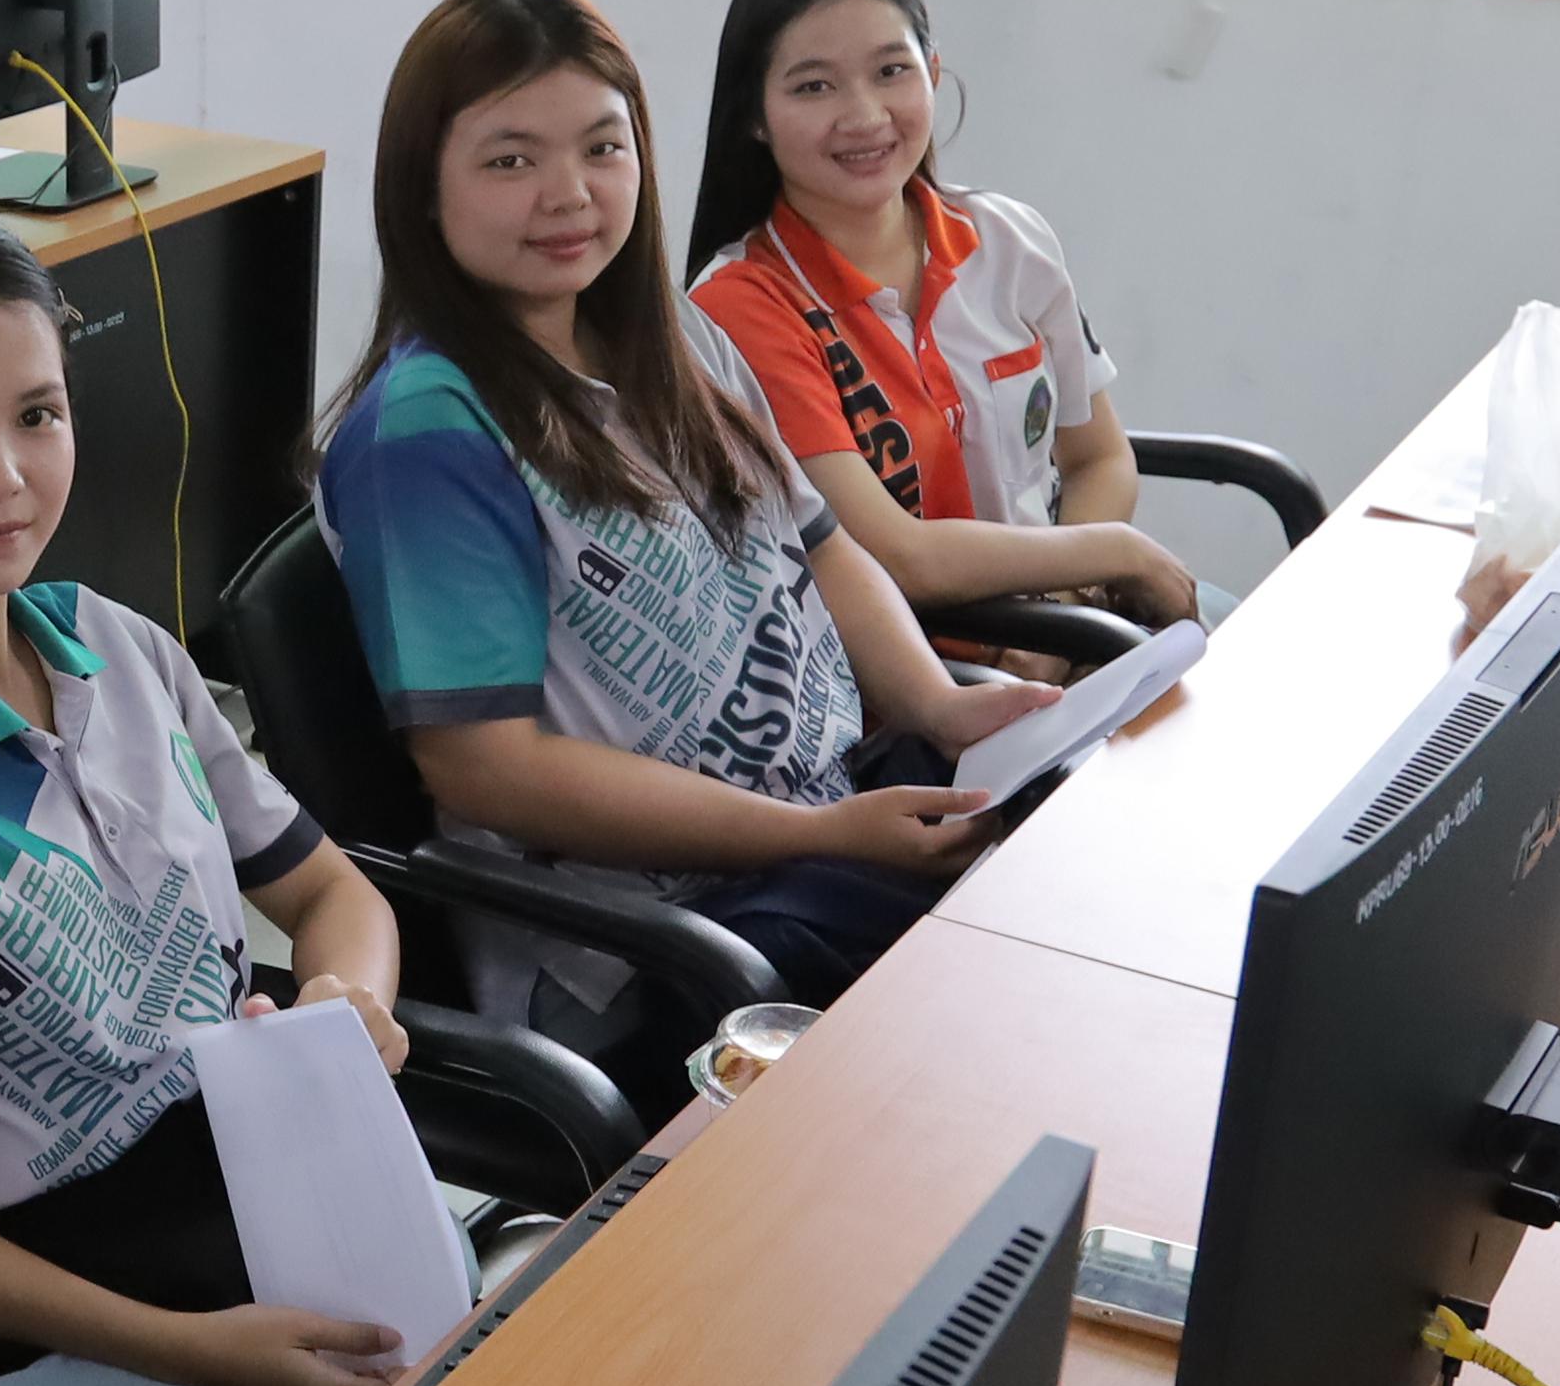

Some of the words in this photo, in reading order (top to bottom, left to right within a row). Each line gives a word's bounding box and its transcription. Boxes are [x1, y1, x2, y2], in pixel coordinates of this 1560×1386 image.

[553, 578, 699, 721] MATERIAL
[18, 862, 143, 1002] CUSTOMER
[129, 859, 191, 967] SEAFREIGHT
[132, 905, 209, 1029] FORWARDER
[31, 1106, 58, 1130] AIR
[159, 1069, 188, 1098] IN
[26, 1127, 83, 1181] DEMAND
